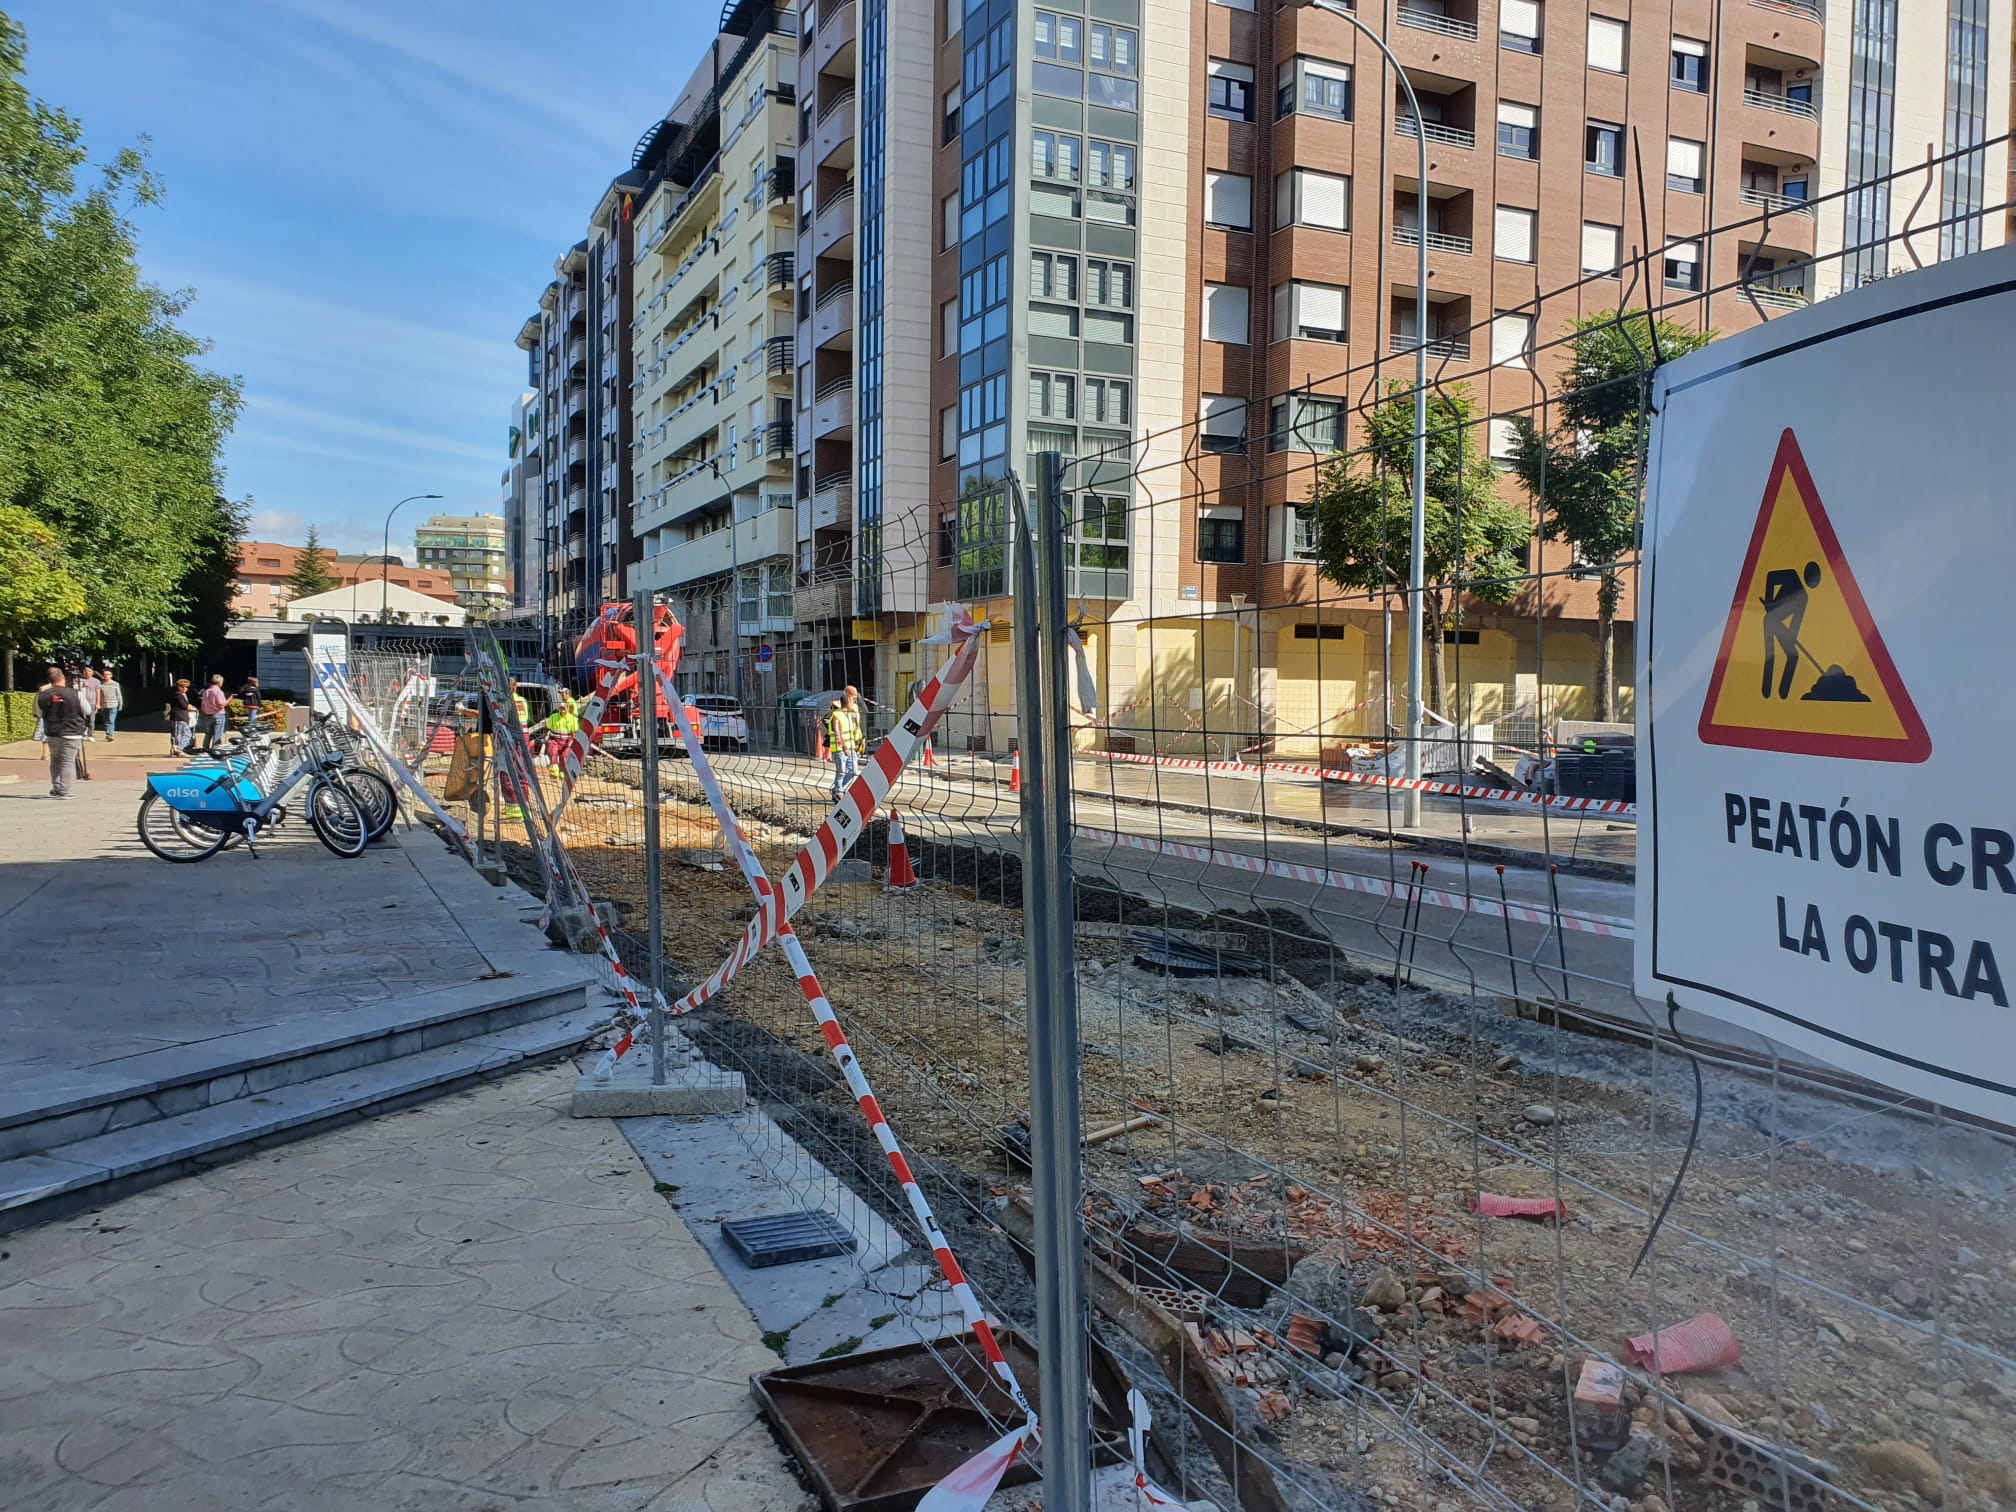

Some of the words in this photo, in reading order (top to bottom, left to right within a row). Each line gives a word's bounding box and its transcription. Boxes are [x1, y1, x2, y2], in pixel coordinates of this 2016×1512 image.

[167, 787, 199, 798] alsa
[1724, 792, 1901, 877] PEATÓN
[1923, 823, 2016, 894] CR
[1776, 895, 1830, 962] LA
[1844, 914, 2009, 1007] OTRA
